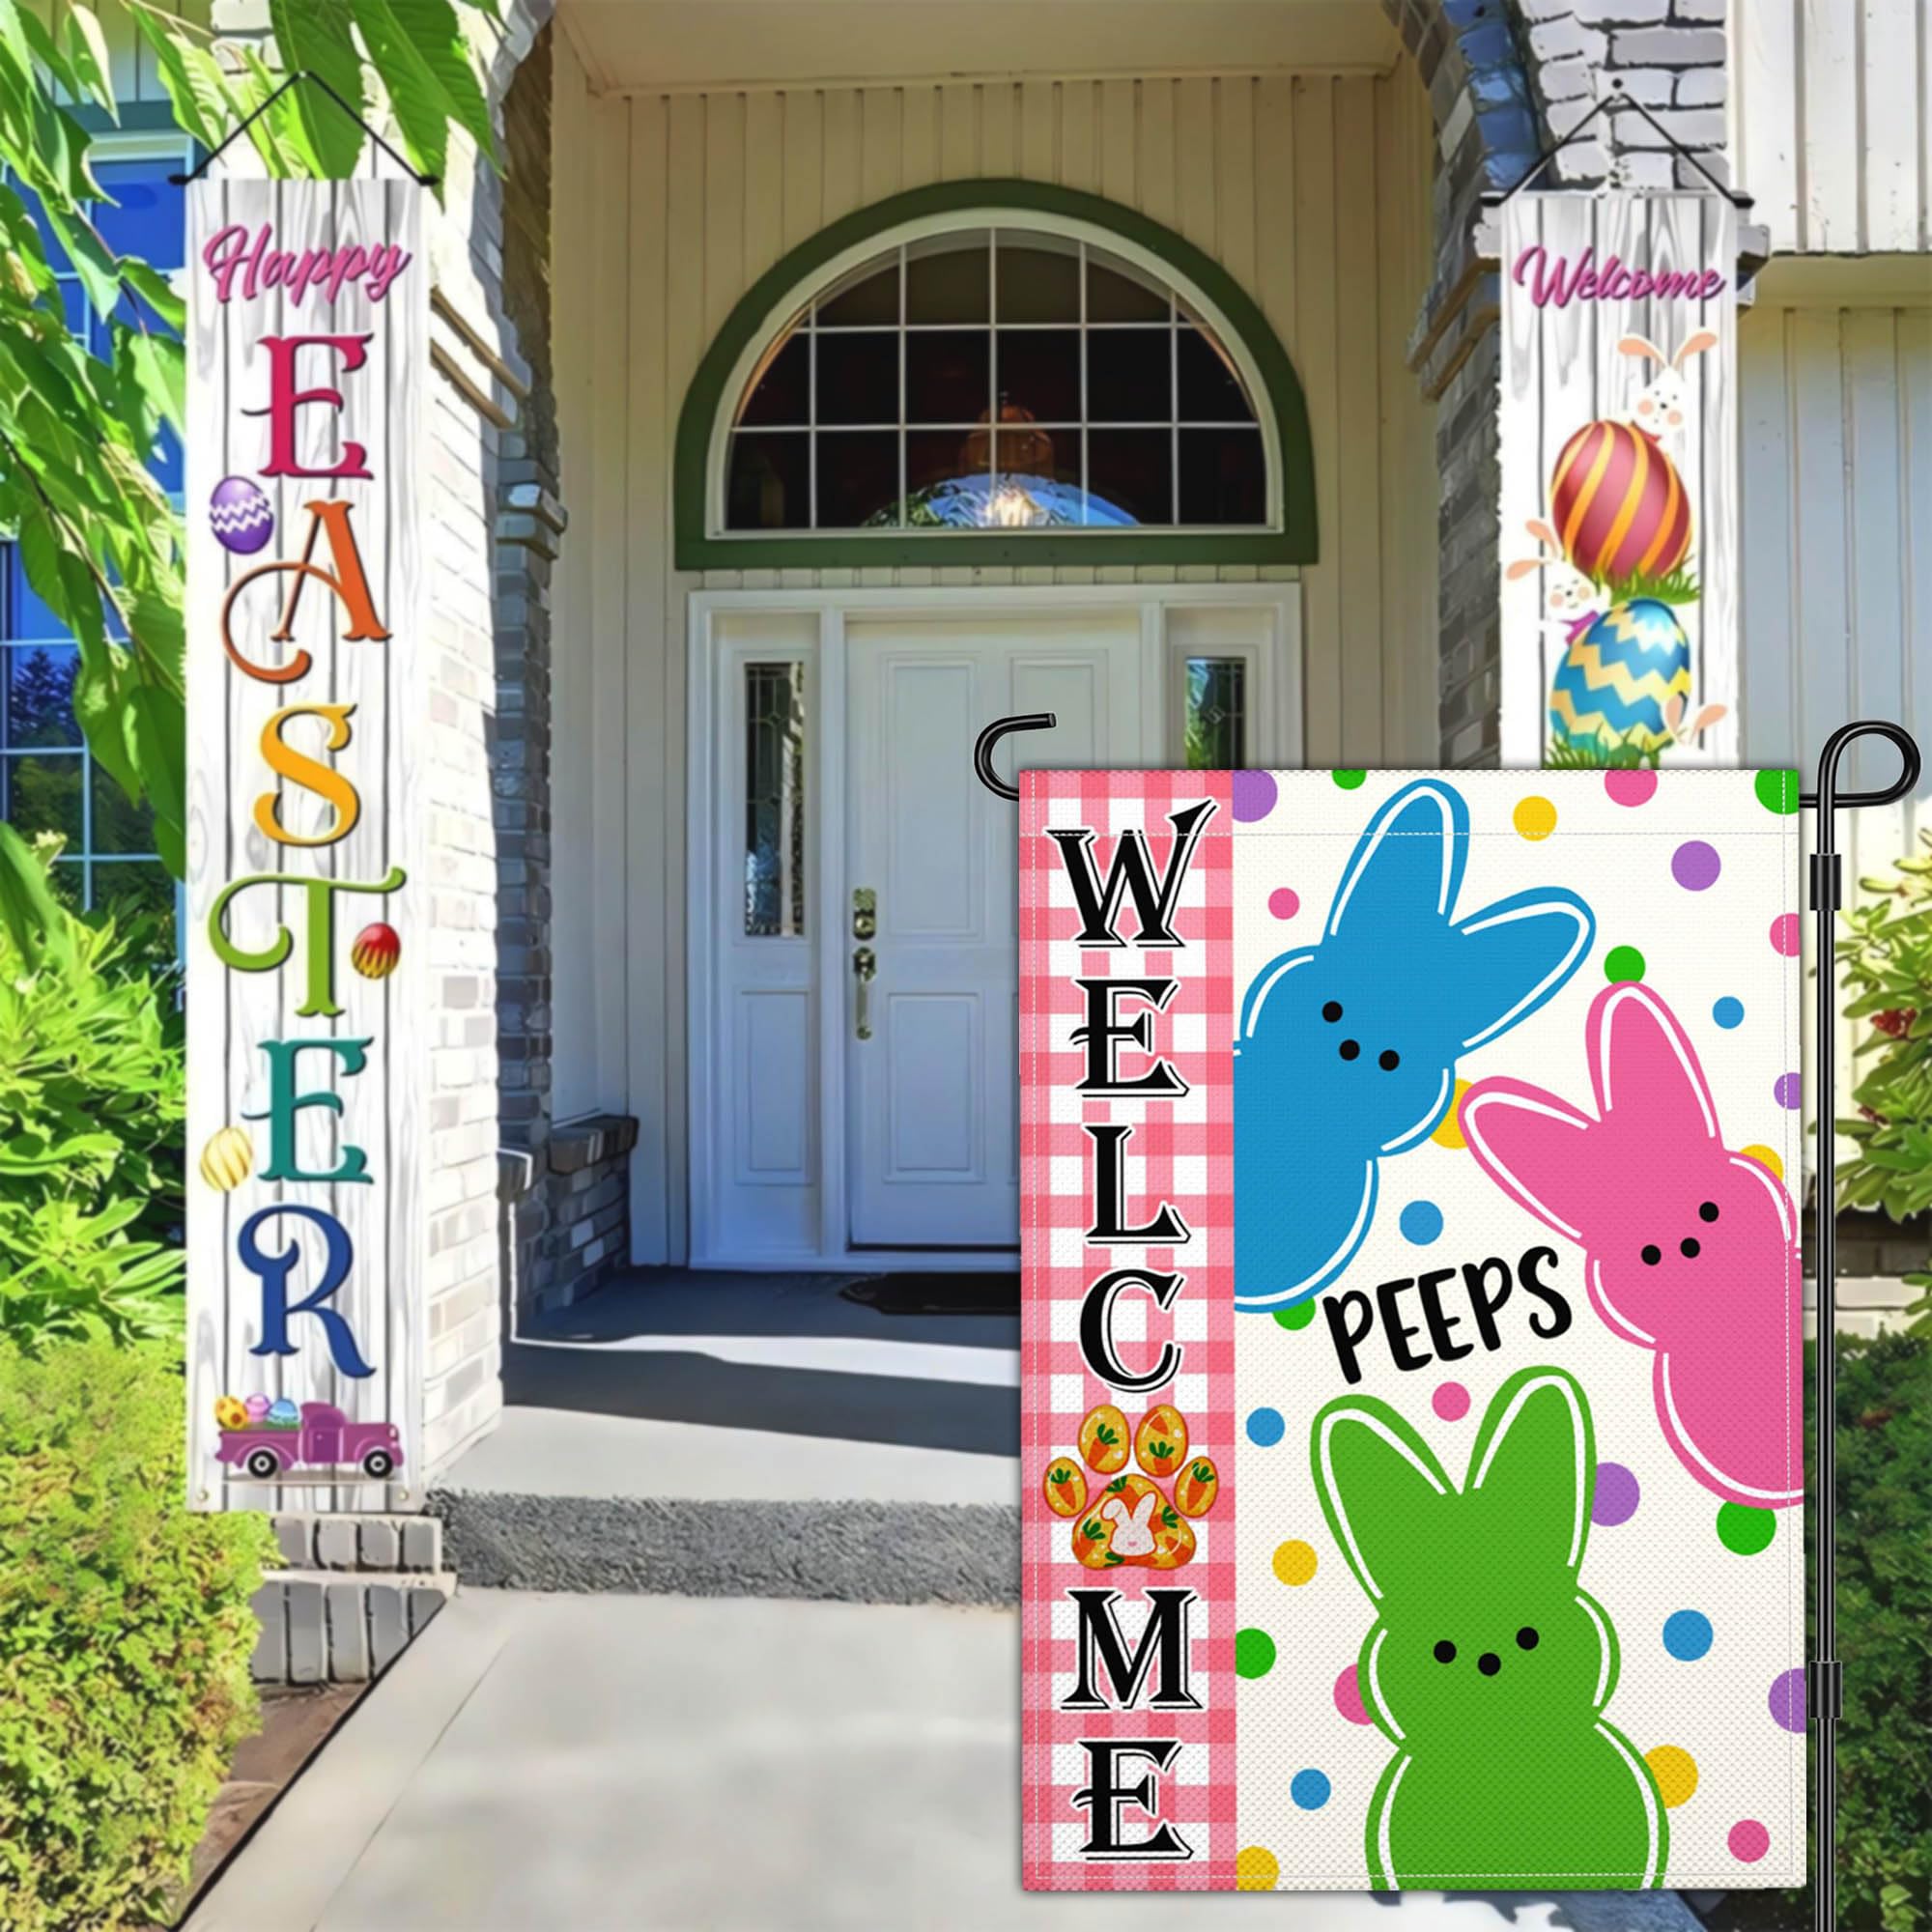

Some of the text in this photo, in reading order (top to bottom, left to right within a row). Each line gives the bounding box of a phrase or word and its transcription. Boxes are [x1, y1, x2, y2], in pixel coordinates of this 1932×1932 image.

[203, 222, 412, 307] Happy
[1513, 245, 1727, 309] Welcome
[207, 330, 407, 1379] EASTER
[1045, 798, 1218, 1861] WELCME
[1321, 1244, 1573, 1385] PEEPS
